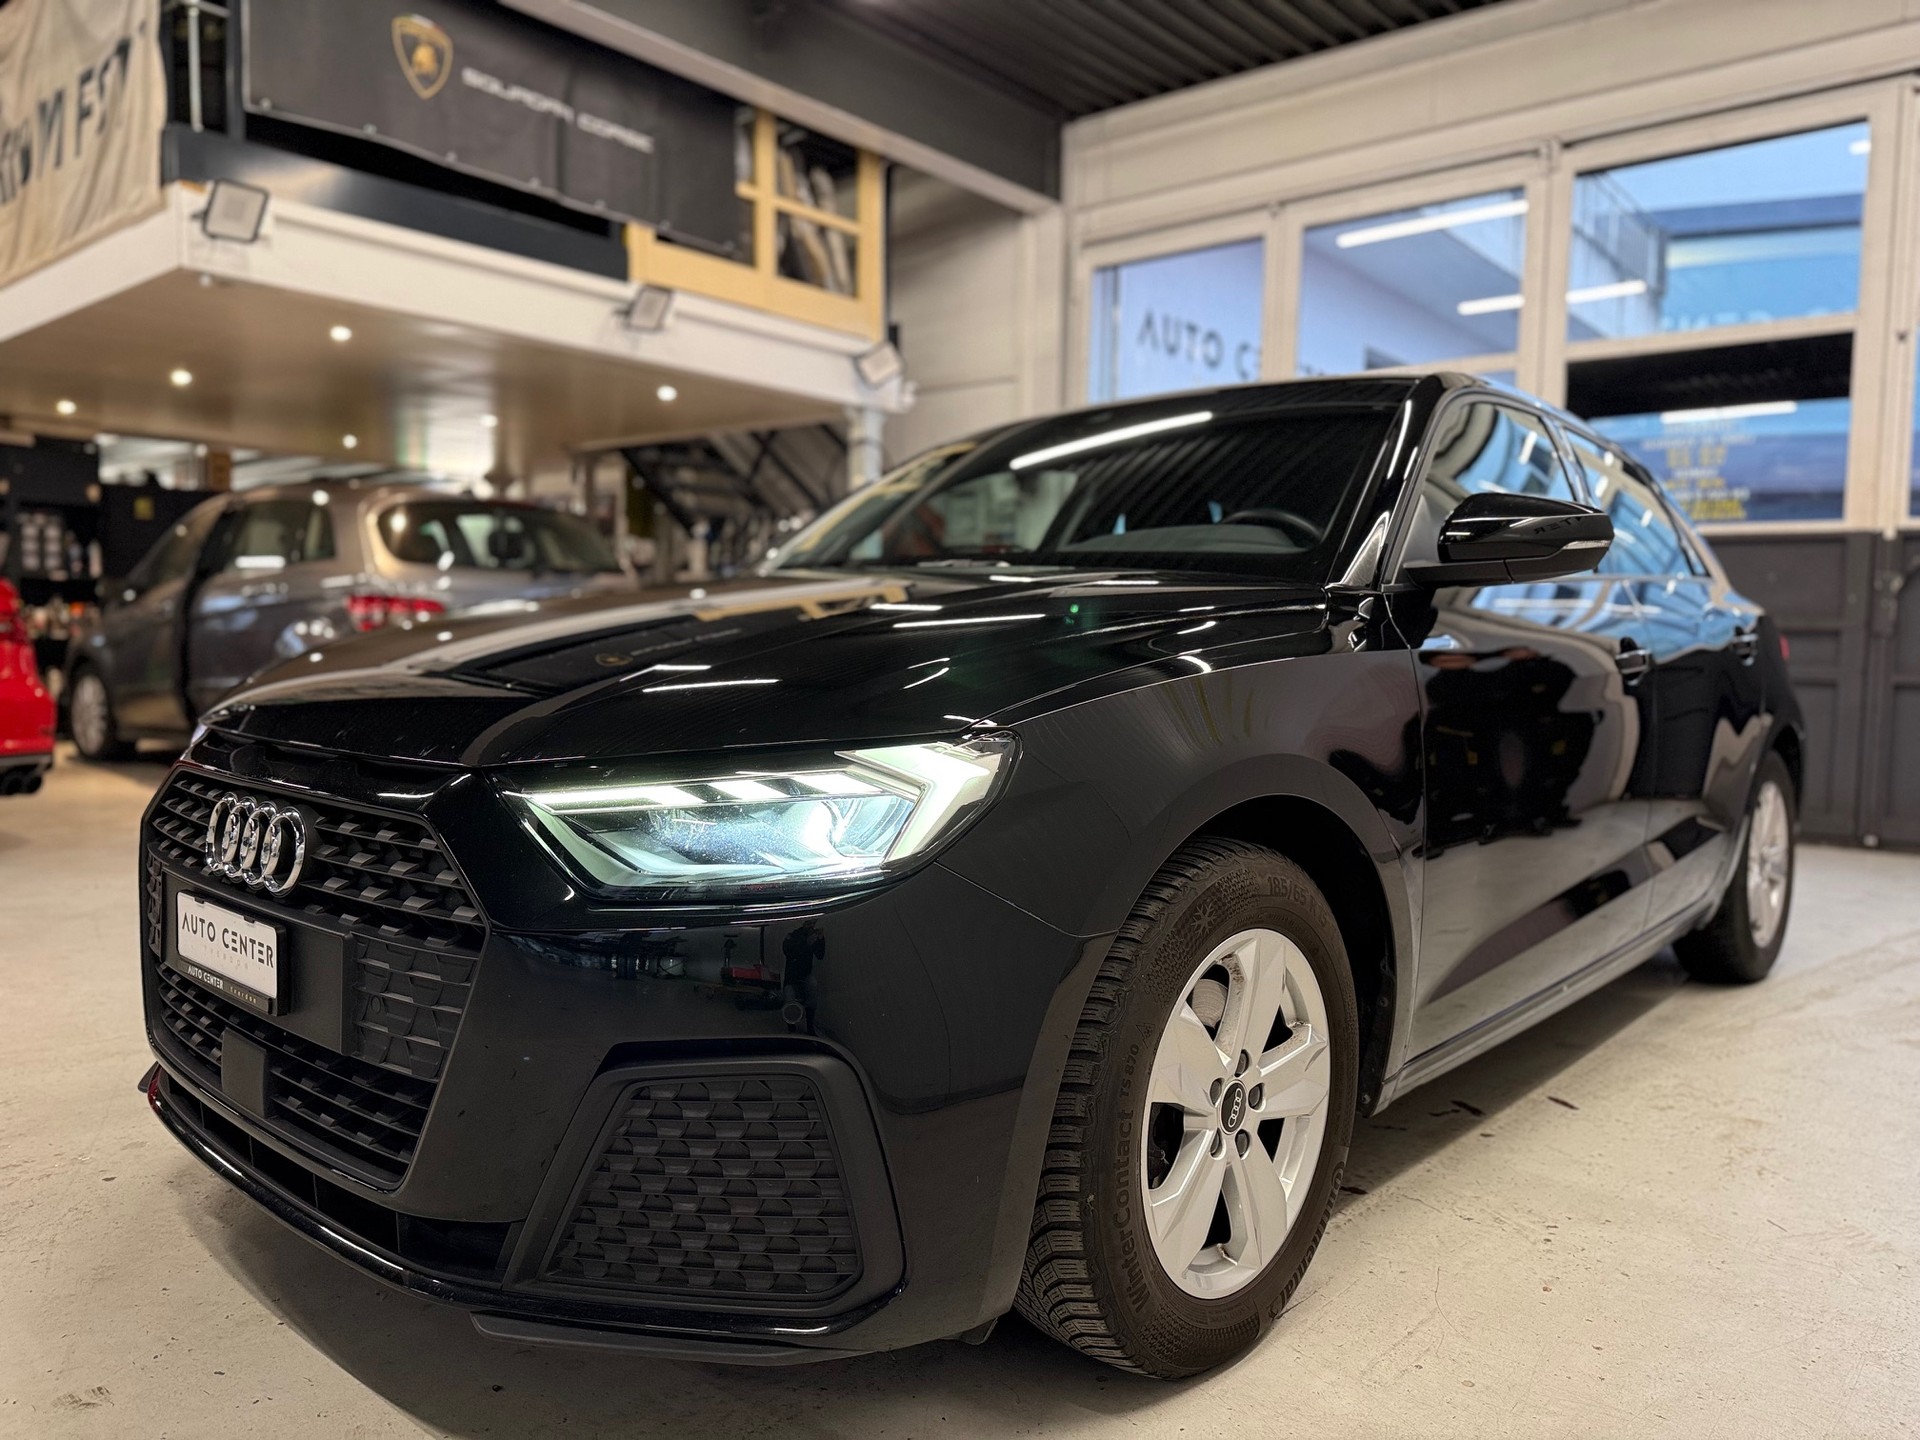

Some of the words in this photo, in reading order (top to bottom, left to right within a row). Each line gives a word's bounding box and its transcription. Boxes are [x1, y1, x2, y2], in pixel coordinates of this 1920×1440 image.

[1137, 309, 1225, 369] AUTO
[182, 912, 216, 942] AUTO
[222, 928, 274, 968] CENTER
[187, 965, 203, 979] AUTO
[203, 972, 224, 990] CENTER
[1113, 1109, 1151, 1315] WinterContact
